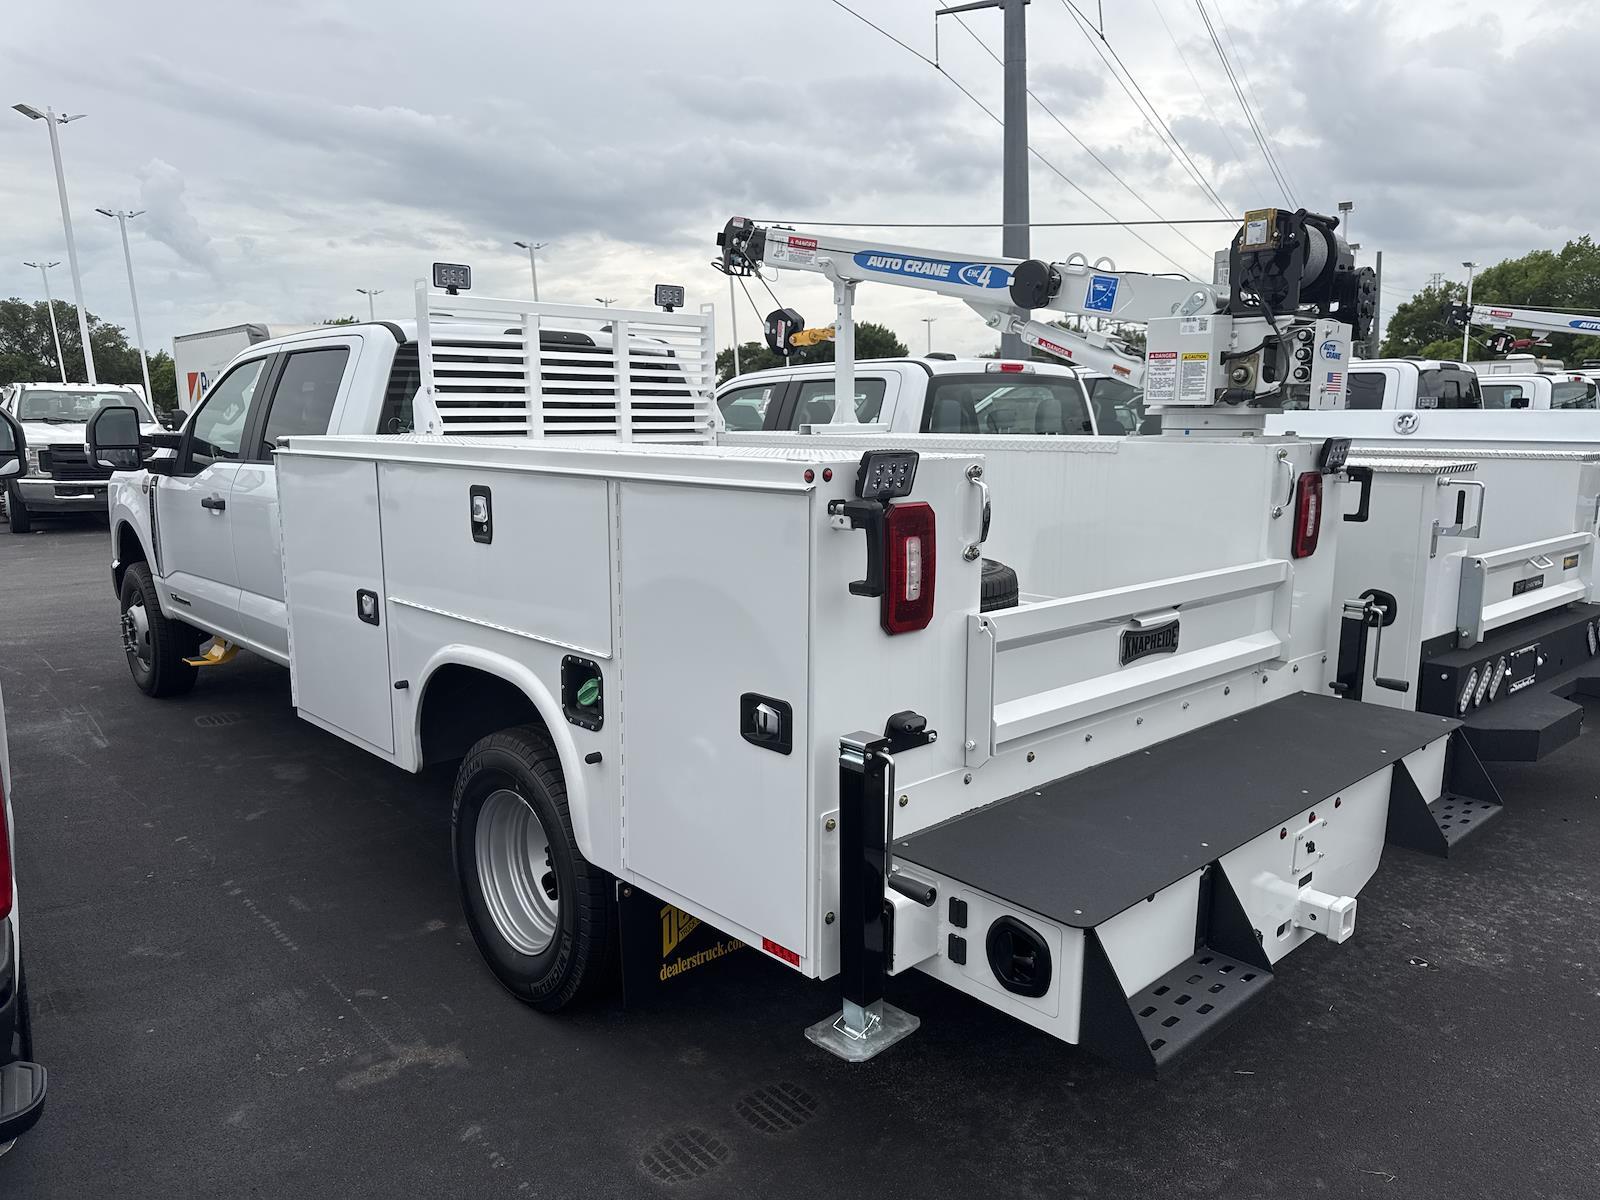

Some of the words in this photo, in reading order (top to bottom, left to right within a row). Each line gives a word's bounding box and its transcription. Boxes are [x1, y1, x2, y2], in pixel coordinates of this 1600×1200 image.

[867, 256, 902, 271] AUTO
[903, 259, 950, 278] CRANE
[977, 265, 992, 289] 4
[1046, 343, 1070, 356] DANGER
[1325, 351, 1341, 360] CRANE
[1124, 626, 1178, 660] KNAPHEIDE
